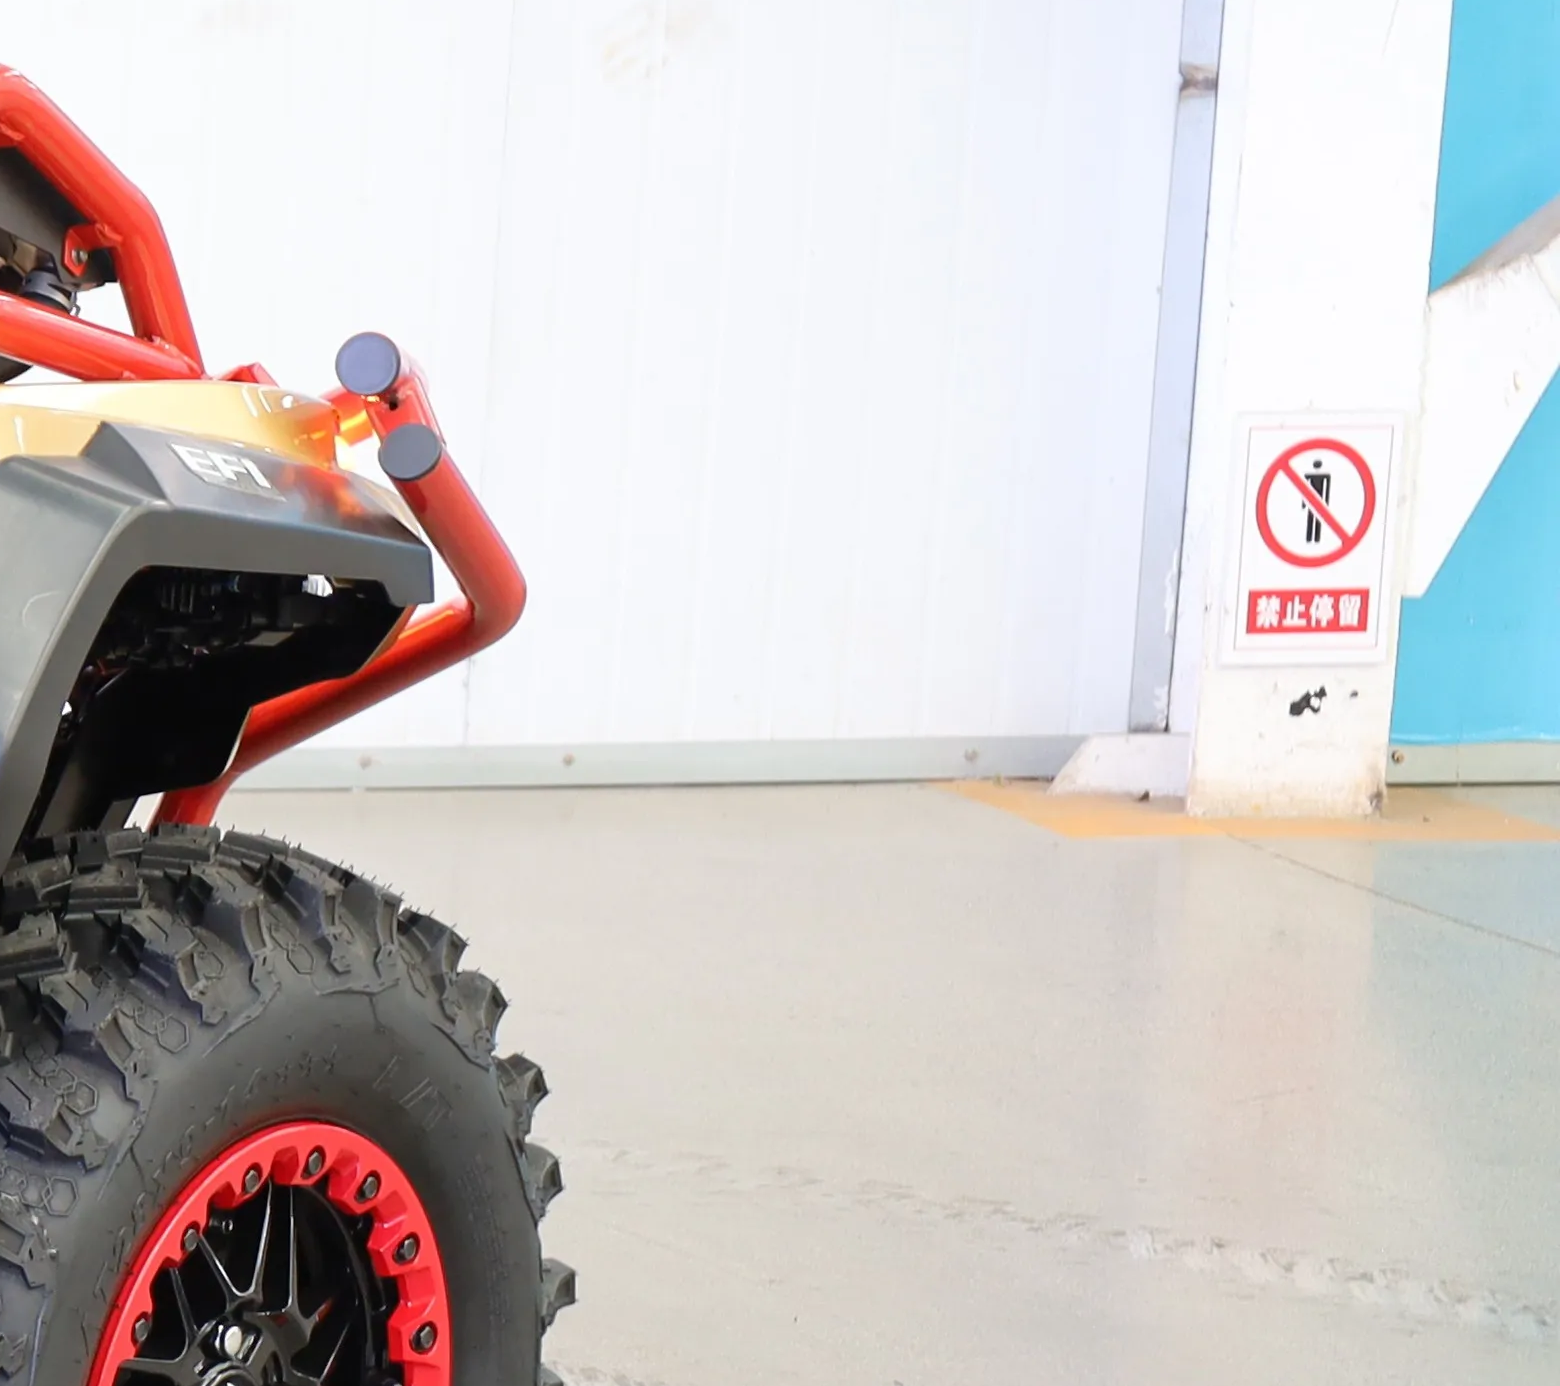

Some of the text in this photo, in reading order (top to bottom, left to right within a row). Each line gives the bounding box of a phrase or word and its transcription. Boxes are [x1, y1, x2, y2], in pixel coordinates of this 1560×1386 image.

[170, 443, 272, 490] EFI
[1255, 593, 1362, 628] 禁止停留
